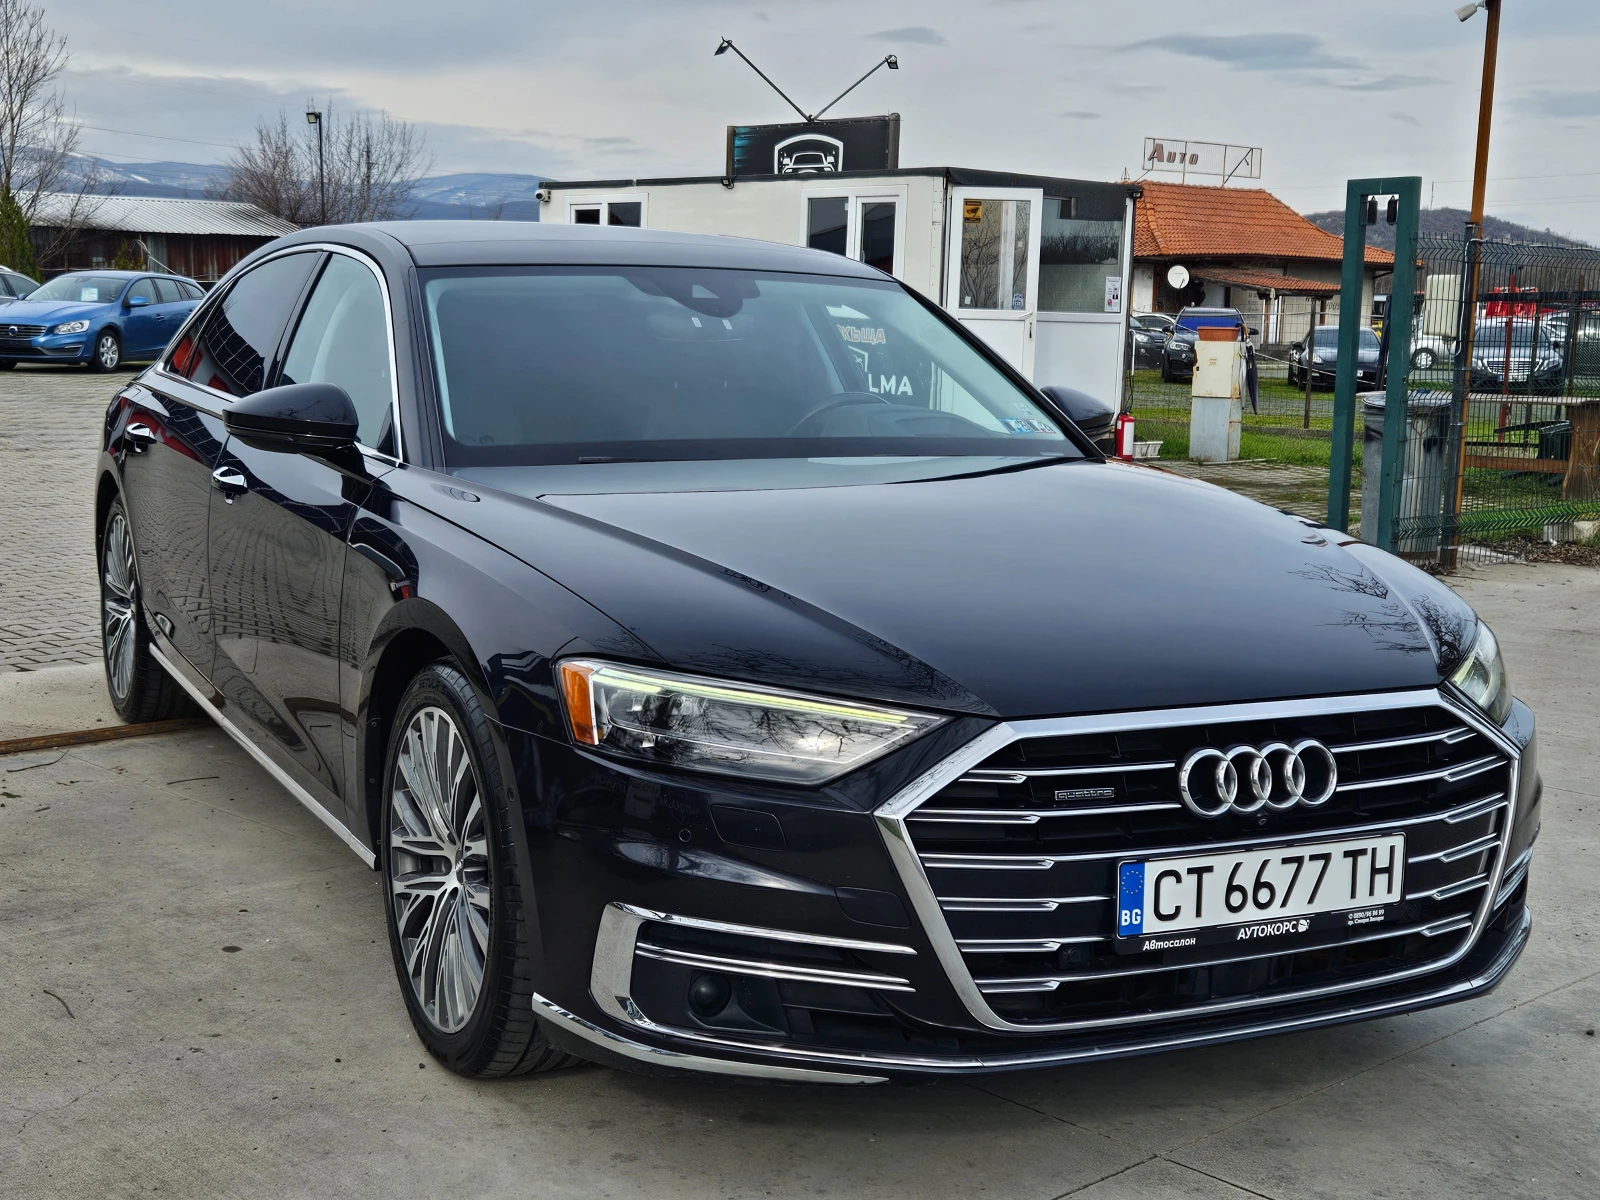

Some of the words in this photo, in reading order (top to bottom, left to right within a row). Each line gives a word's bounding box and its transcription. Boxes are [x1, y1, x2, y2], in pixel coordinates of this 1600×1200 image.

[837, 324, 887, 345] КЪЩА
[1058, 790, 1113, 800] quattro
[1153, 865, 1214, 922] CT
[1224, 852, 1333, 914] 6677
[1343, 844, 1396, 900] TH
[1121, 908, 1142, 926] BG
[1236, 920, 1297, 941] АУТОКОРС
[1142, 937, 1196, 951] Автосалон
